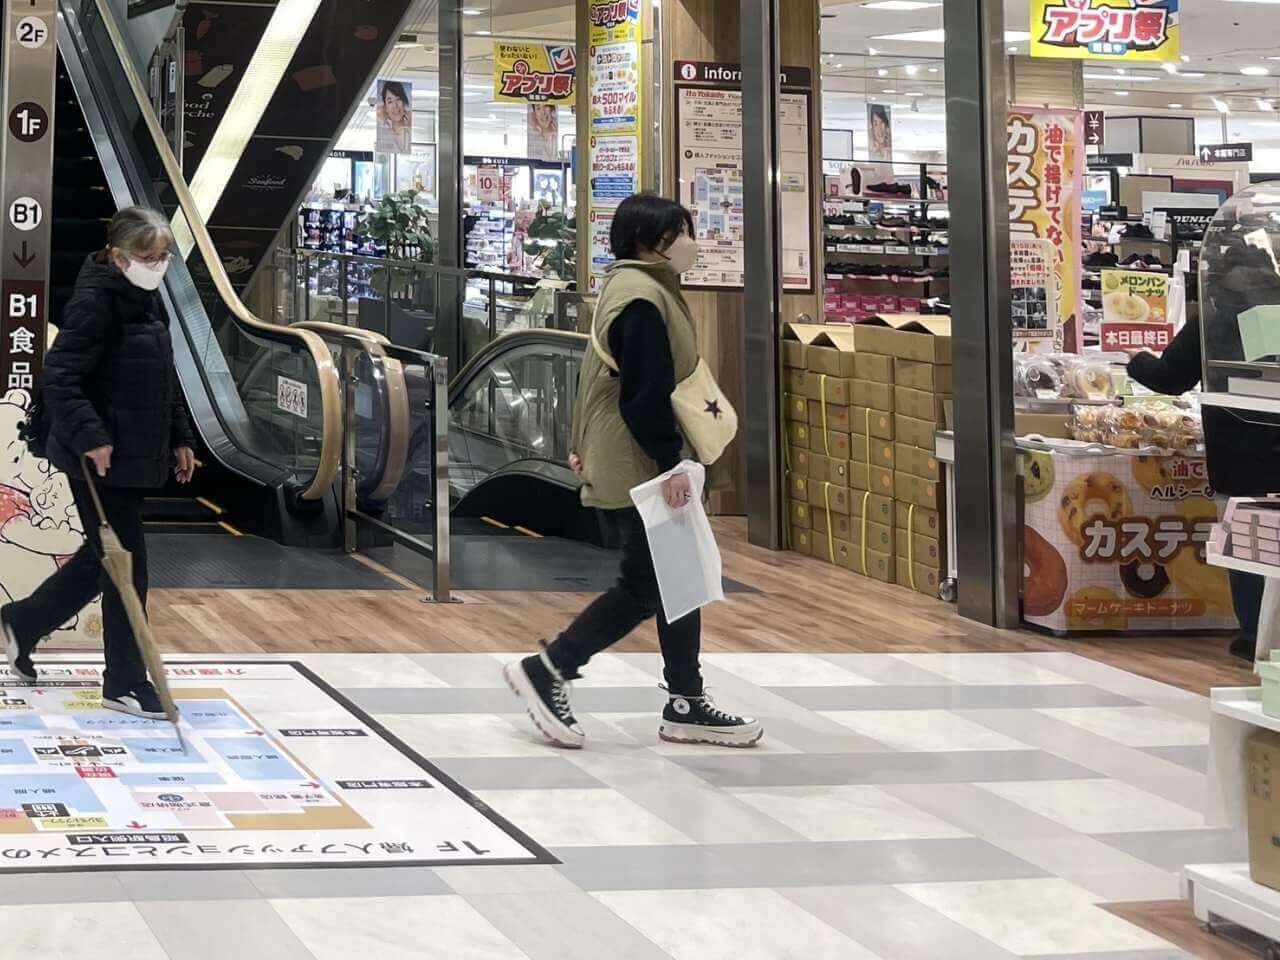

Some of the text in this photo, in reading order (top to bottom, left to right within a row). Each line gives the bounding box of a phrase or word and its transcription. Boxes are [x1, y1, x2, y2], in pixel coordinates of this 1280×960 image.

[20, 22, 44, 42] 2F
[1049, 10, 1164, 42] アプリ祭
[17, 109, 41, 136] 1F
[13, 204, 38, 224] B1
[1120, 276, 1166, 287] メロンパン
[1129, 287, 1164, 297] ドーナツ
[9, 294, 37, 318] B1
[1104, 330, 1169, 346] 本日最終日
[8, 326, 35, 388] 食品
[1073, 600, 1193, 616] マームケーキドーナツ
[436, 841, 491, 855] 1F
